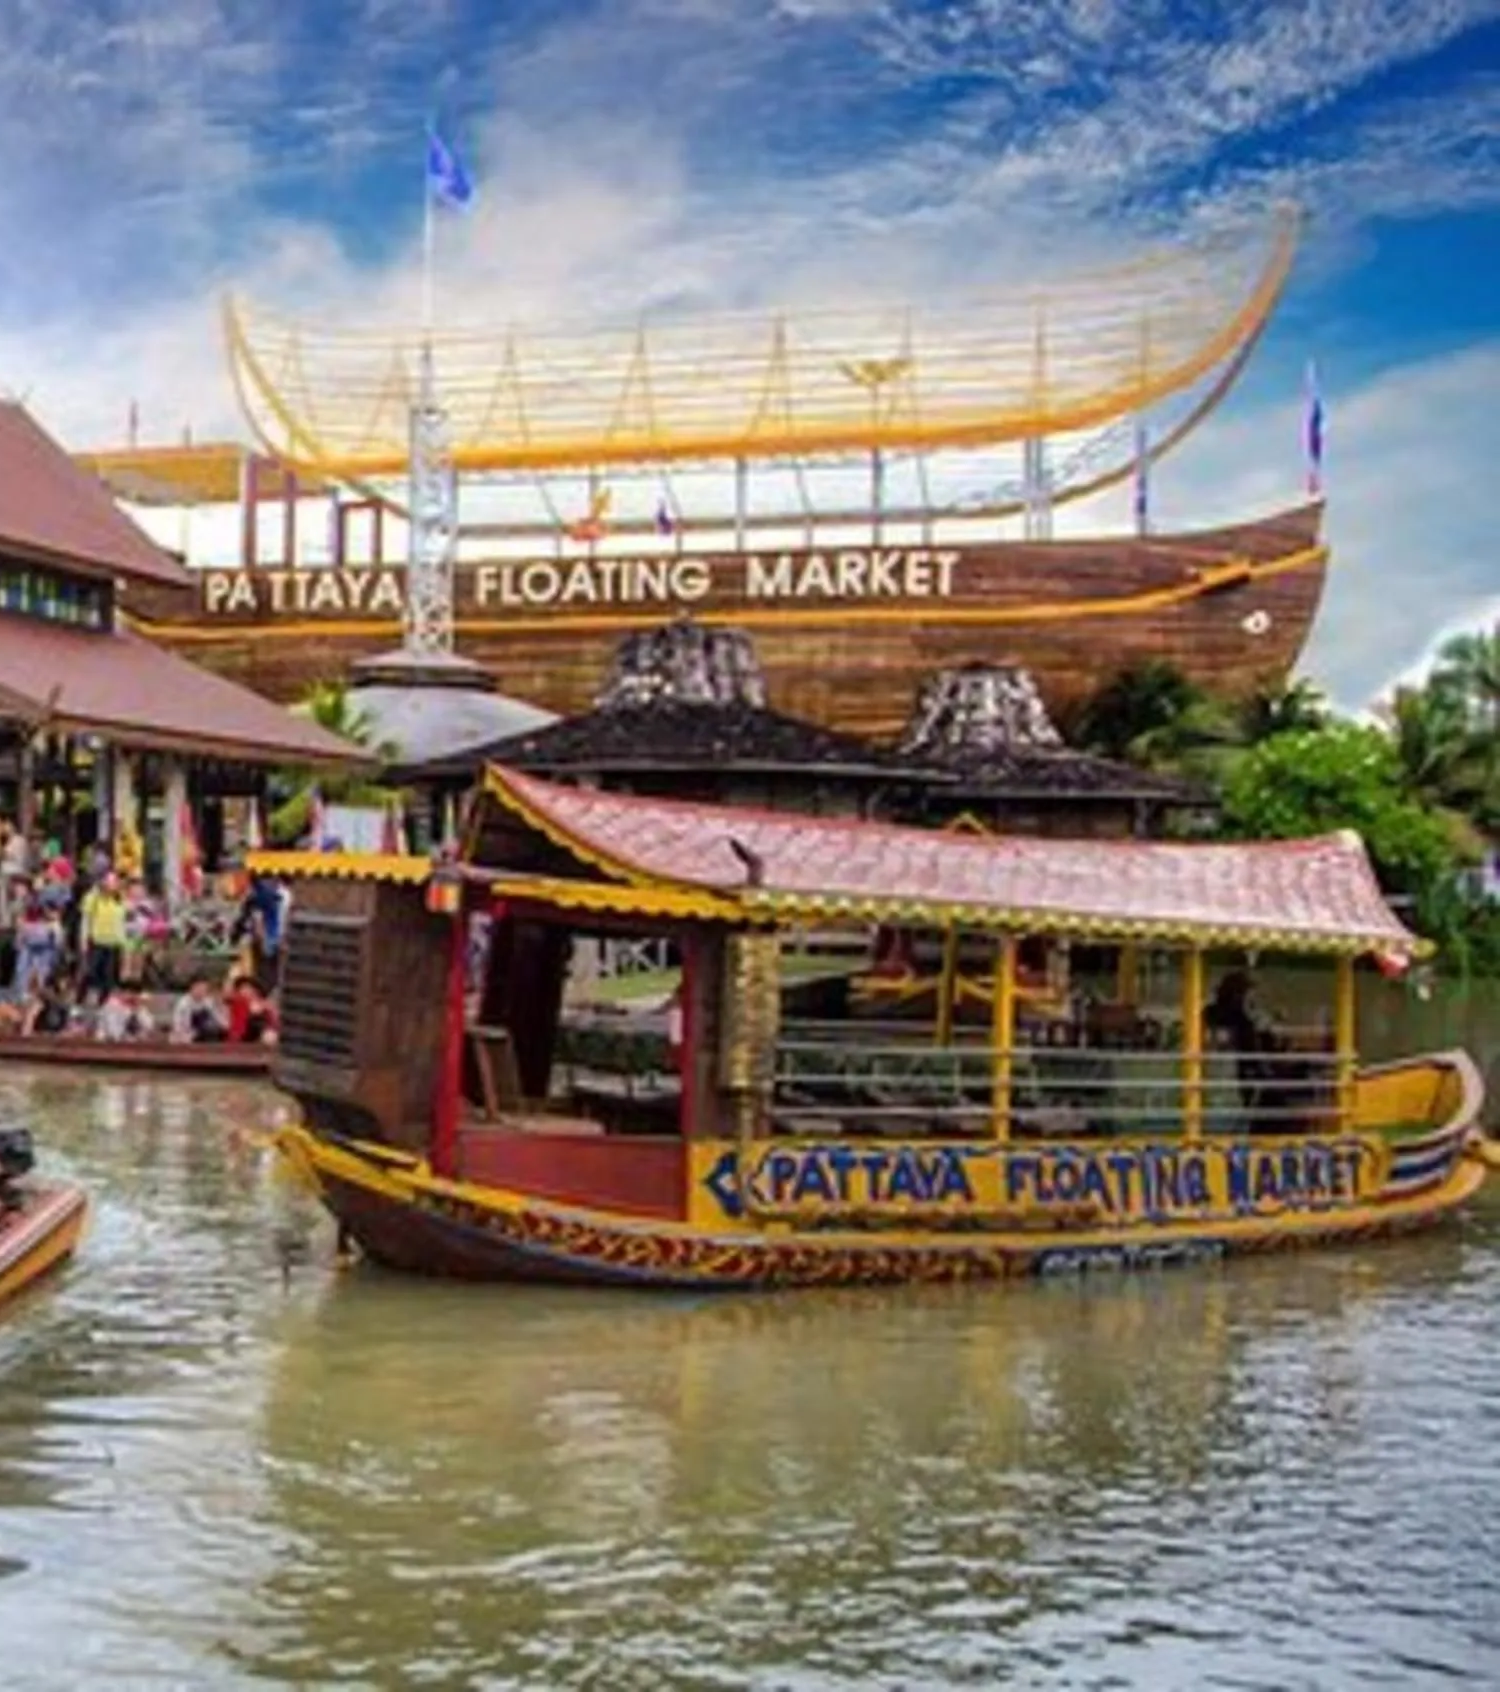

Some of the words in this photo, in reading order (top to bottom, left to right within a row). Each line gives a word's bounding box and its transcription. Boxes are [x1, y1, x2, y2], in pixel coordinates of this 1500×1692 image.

[204, 569, 402, 613] PATTAYA
[474, 559, 712, 607] FLOATING
[746, 549, 961, 597] MARKET
[765, 1147, 979, 1204] PATTAYA
